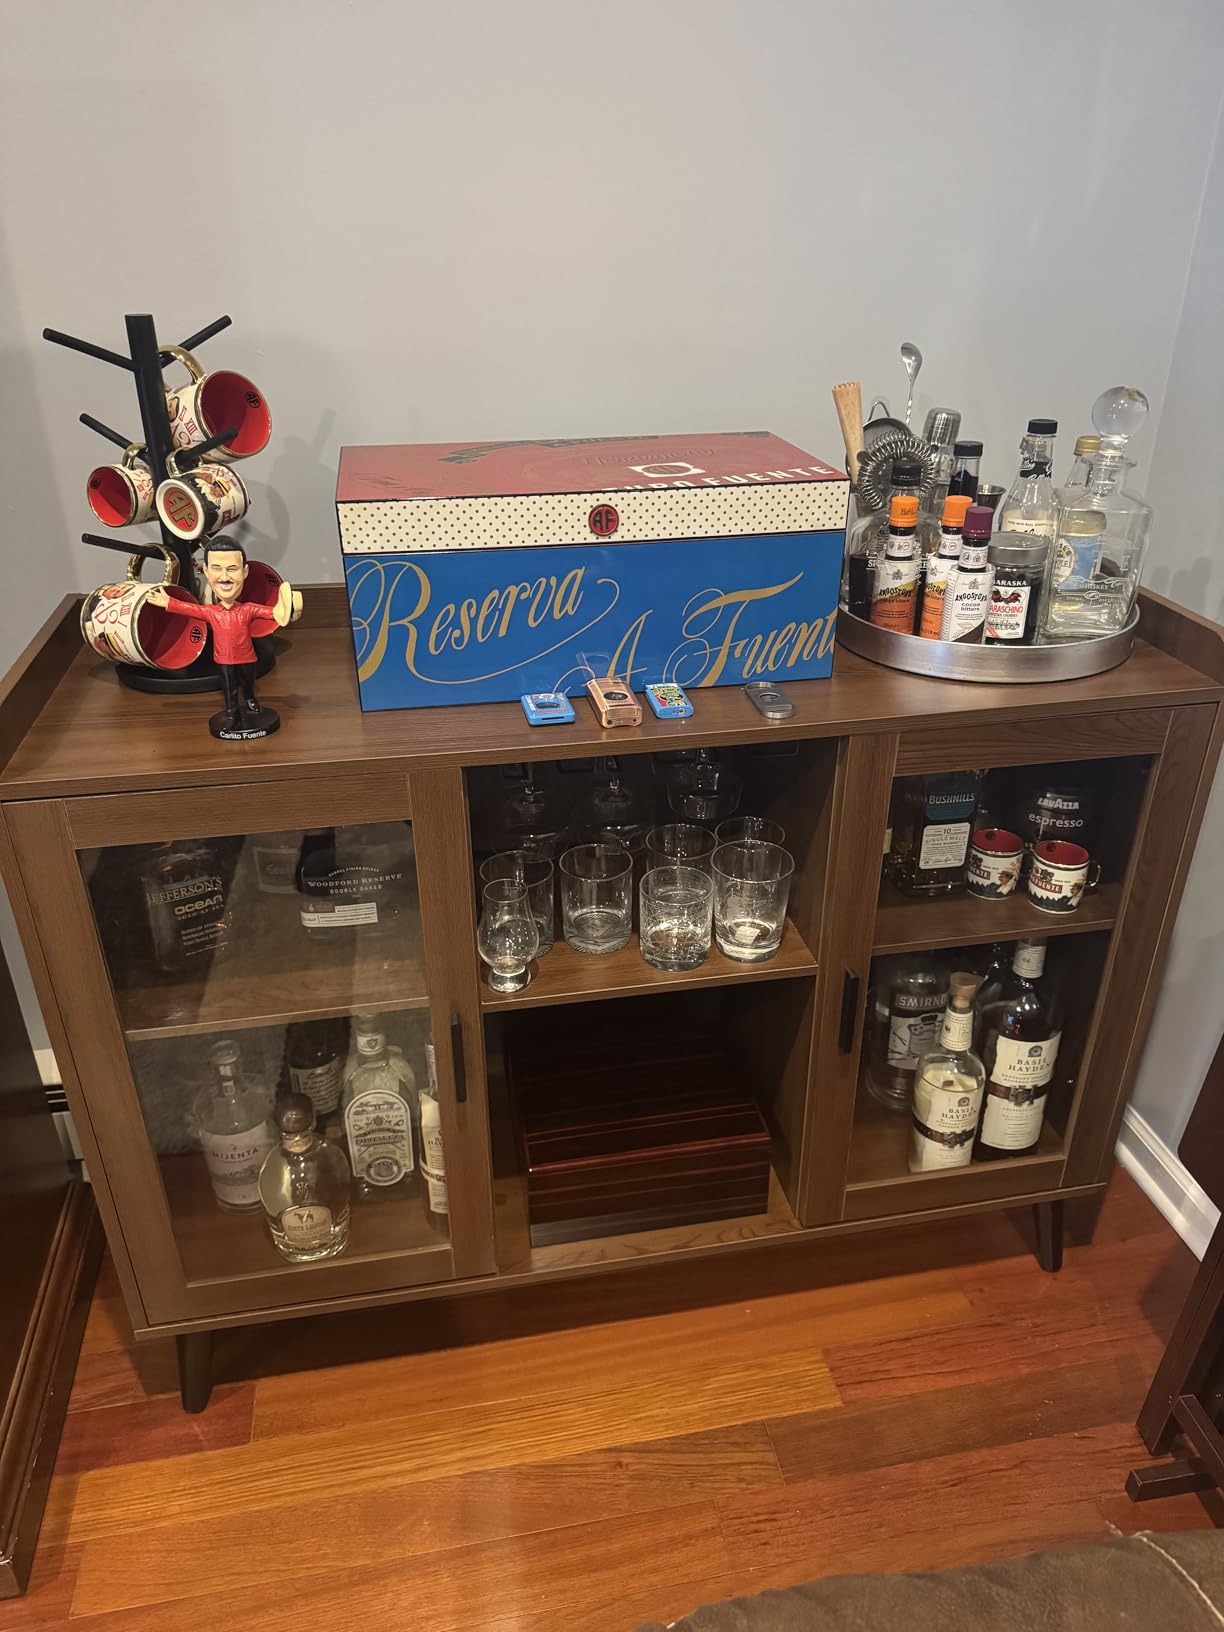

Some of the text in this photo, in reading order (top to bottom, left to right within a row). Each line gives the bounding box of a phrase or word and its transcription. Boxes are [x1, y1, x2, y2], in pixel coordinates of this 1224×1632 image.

[701, 465, 835, 487] FUENTE
[989, 604, 1024, 613] ARASCHINO
[346, 558, 598, 684] Reserva
[668, 572, 835, 688] Fuent
[219, 730, 267, 740] Carlito Fuente
[928, 793, 976, 805] BUSHMILLS
[1037, 797, 1080, 810] LAVAZZA
[1028, 813, 1084, 834] espresso
[308, 873, 403, 888] WOODFORD RESERVE
[329, 884, 384, 894] DOUBLE OAKED
[1008, 1063, 1051, 1072] HAYDEN
[941, 1110, 977, 1119] HAYDEN
[948, 1106, 974, 1114] BASIL
[211, 1147, 259, 1162] MIJENTA
